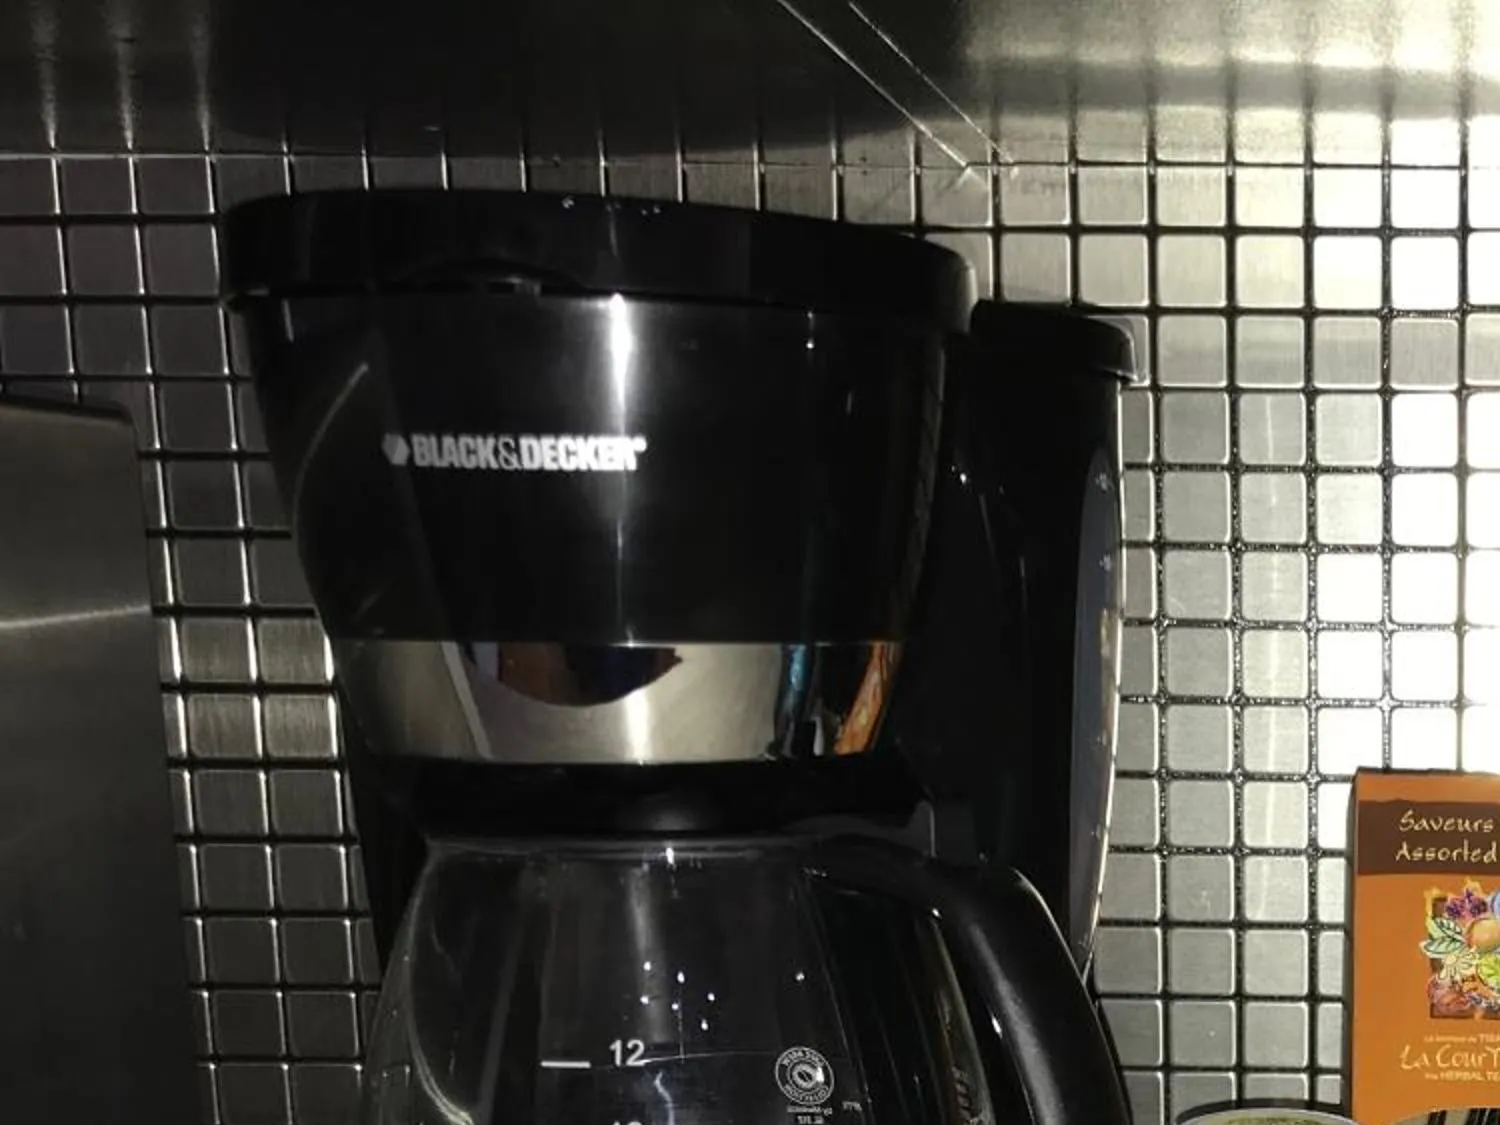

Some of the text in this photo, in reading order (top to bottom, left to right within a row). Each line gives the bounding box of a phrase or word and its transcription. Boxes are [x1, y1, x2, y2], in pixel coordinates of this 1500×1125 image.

[1398, 809, 1495, 833] Saveurs
[1395, 839, 1498, 864] Assorted
[608, 1039, 646, 1066] 12
[1400, 1044, 1431, 1070] La
